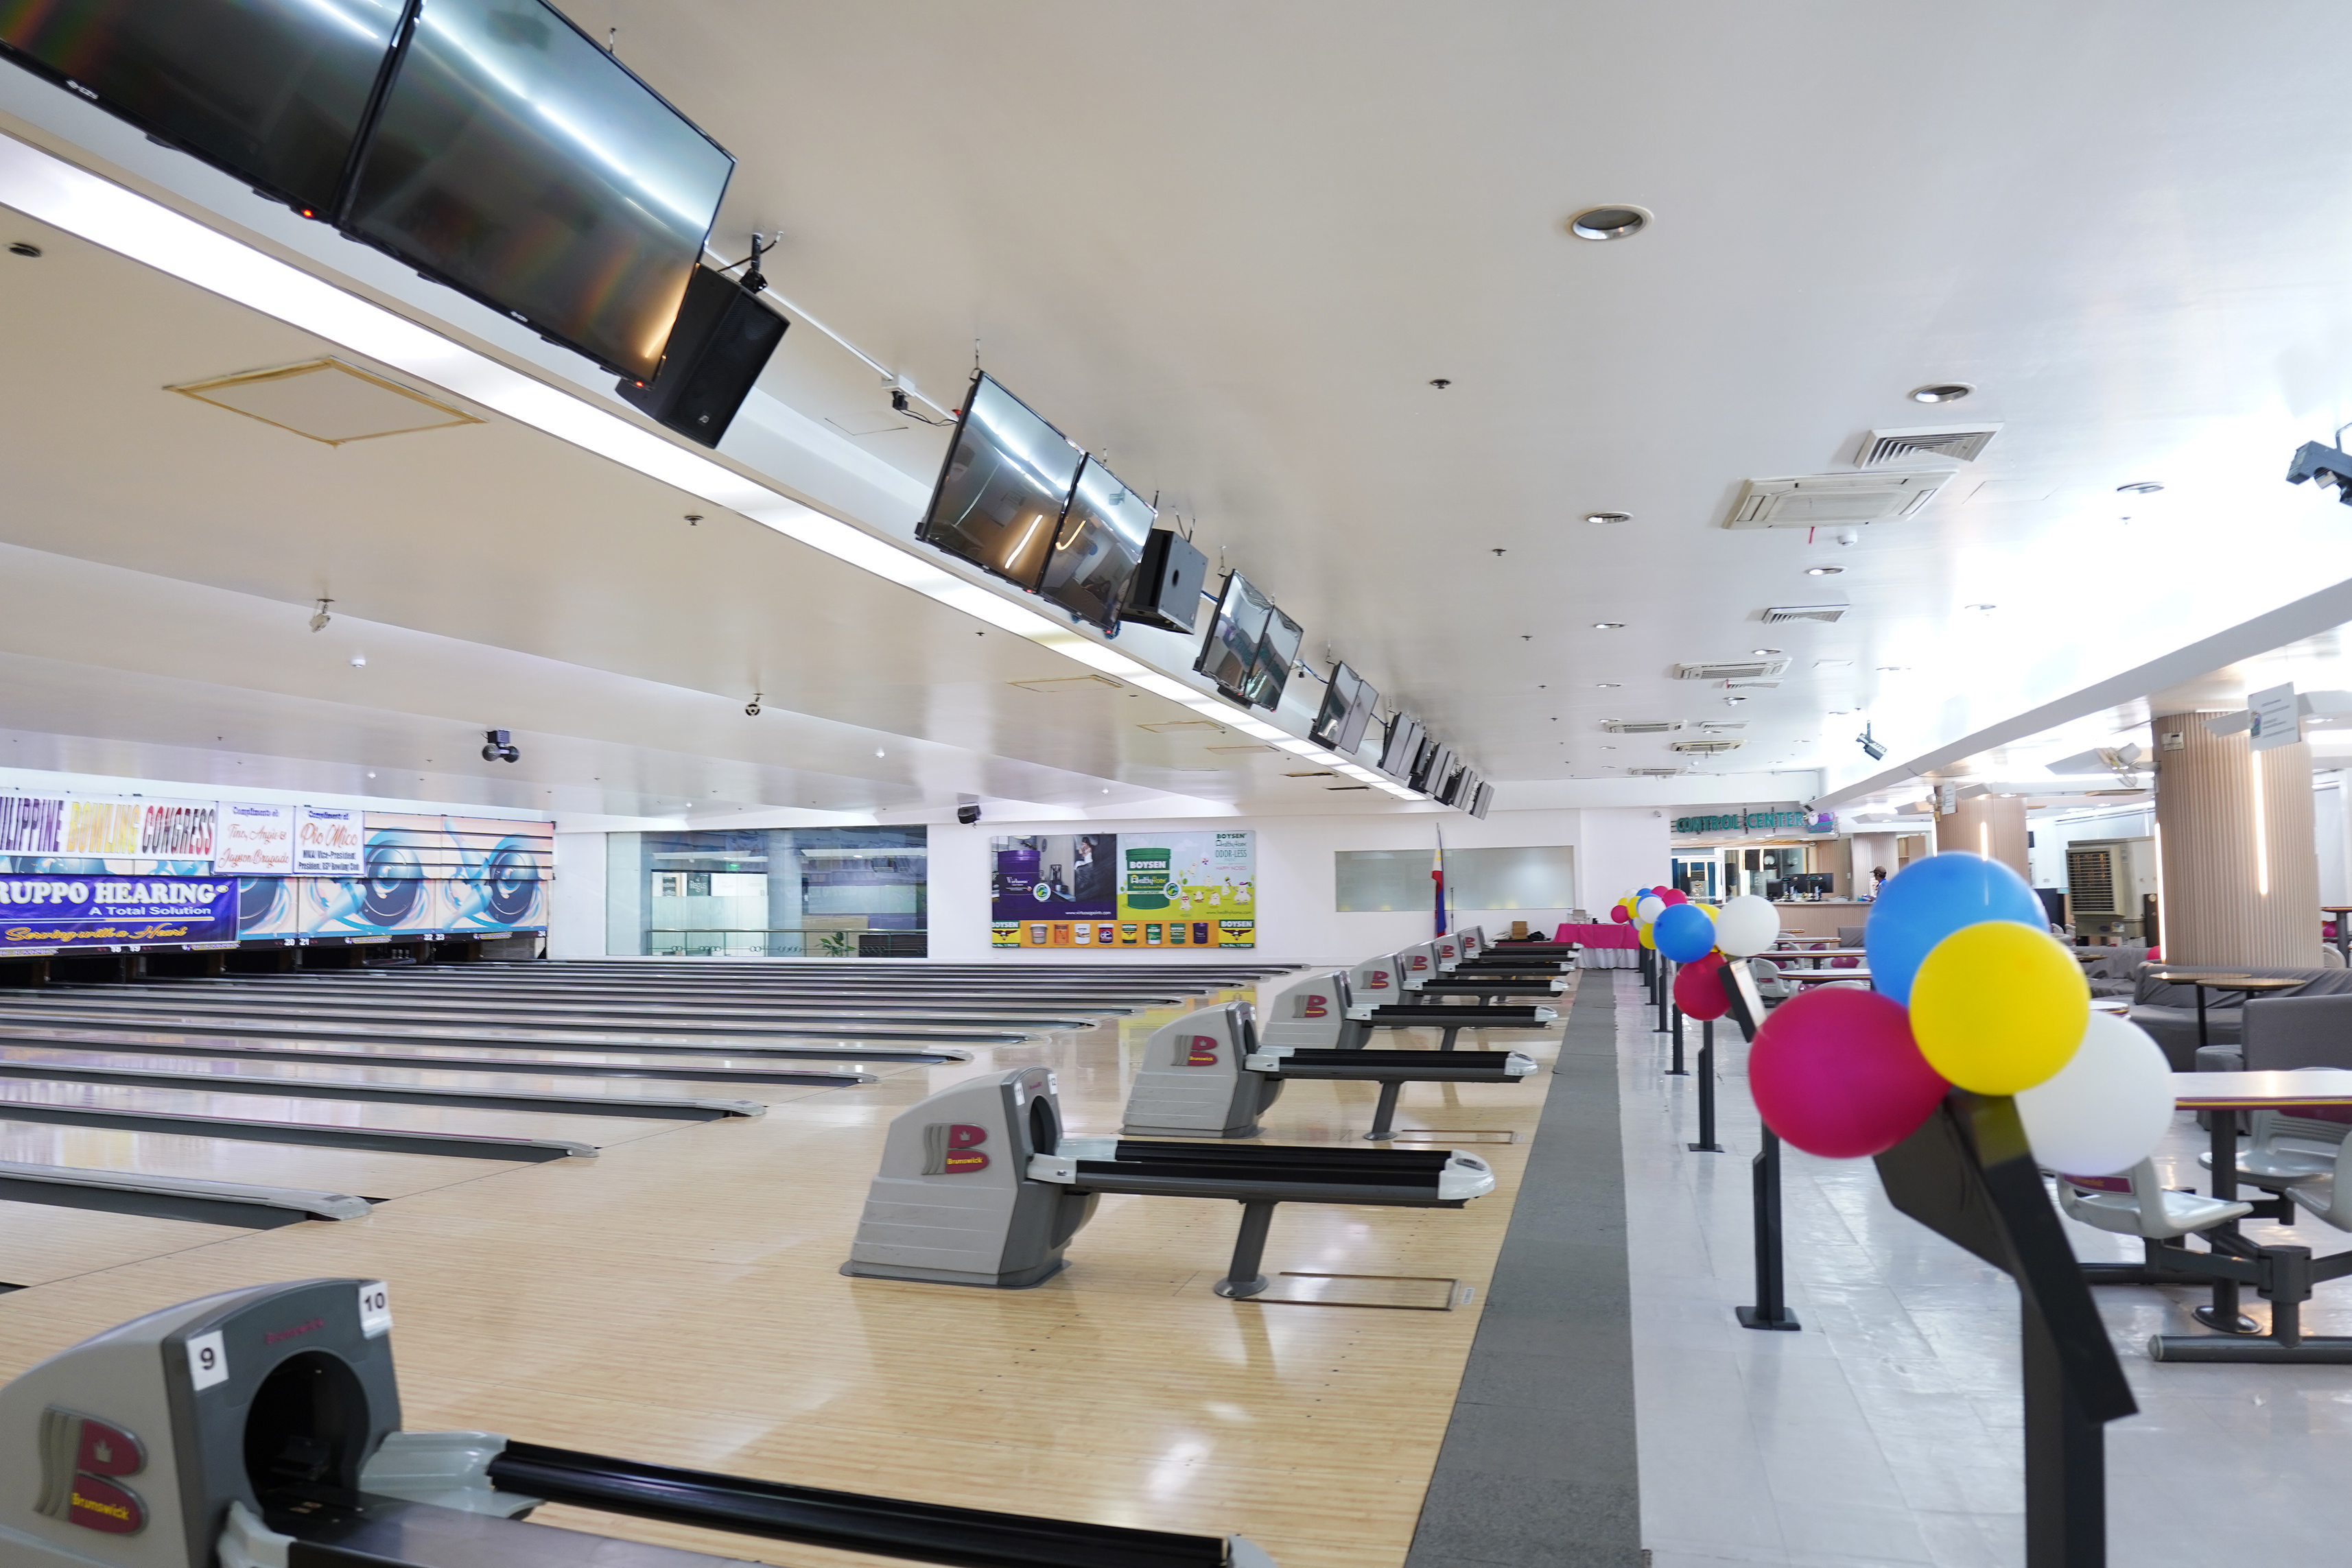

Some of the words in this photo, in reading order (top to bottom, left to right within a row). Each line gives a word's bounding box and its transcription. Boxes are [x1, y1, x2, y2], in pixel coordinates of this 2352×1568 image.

[67, 801, 140, 854] BOWLING
[142, 805, 215, 855] CONGRESS
[1676, 813, 1741, 833] CONTROL
[1746, 811, 1806, 829] CENTER
[301, 822, 323, 846] Pio
[1129, 861, 1166, 869] BOYSEN
[93, 882, 217, 904] HEARING
[89, 907, 102, 916] A
[105, 907, 145, 915] Total
[149, 907, 211, 915] Solution
[5, 927, 78, 942] Serving
[128, 923, 188, 940] Heart
[364, 1292, 386, 1311] 10
[200, 1346, 215, 1370] 9
[71, 1491, 130, 1521] Brunswick
